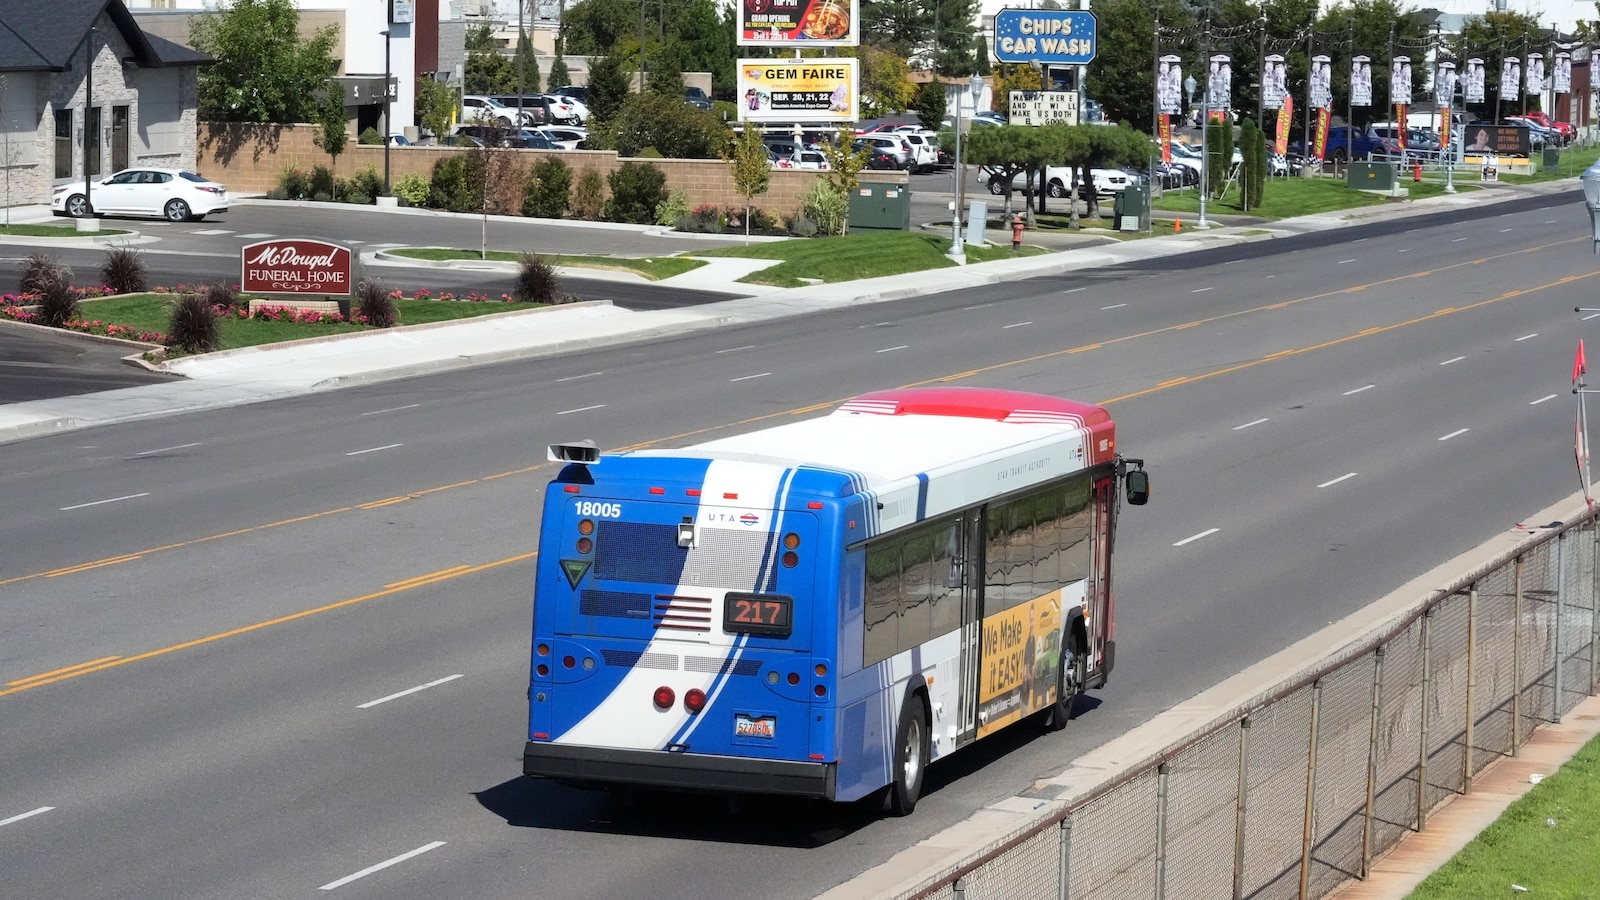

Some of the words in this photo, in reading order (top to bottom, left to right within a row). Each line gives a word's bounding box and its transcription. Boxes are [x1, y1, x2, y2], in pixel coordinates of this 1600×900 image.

[751, 14, 768, 22] GRAND
[1019, 16, 1072, 36] CHIPS
[1001, 37, 1037, 54] CAR
[1040, 38, 1091, 55] WASH
[765, 69, 797, 79] GEM
[803, 69, 844, 79] FAIRE
[792, 94, 804, 102] 20,
[806, 94, 818, 102] 21,
[247, 246, 338, 270] McDougal
[249, 270, 305, 281] FUNERAL
[307, 271, 344, 282] HOME
[997, 472, 1008, 481] UTAH
[1010, 463, 1027, 476] TRANSIT
[1028, 457, 1051, 471] AUTHORITY
[575, 501, 621, 518] 18005
[708, 513, 735, 522] UTA
[735, 600, 781, 624] 217
[984, 624, 998, 658] We
[1000, 615, 1022, 652] Make
[989, 662, 997, 694] it
[998, 648, 1024, 690] EASY!
